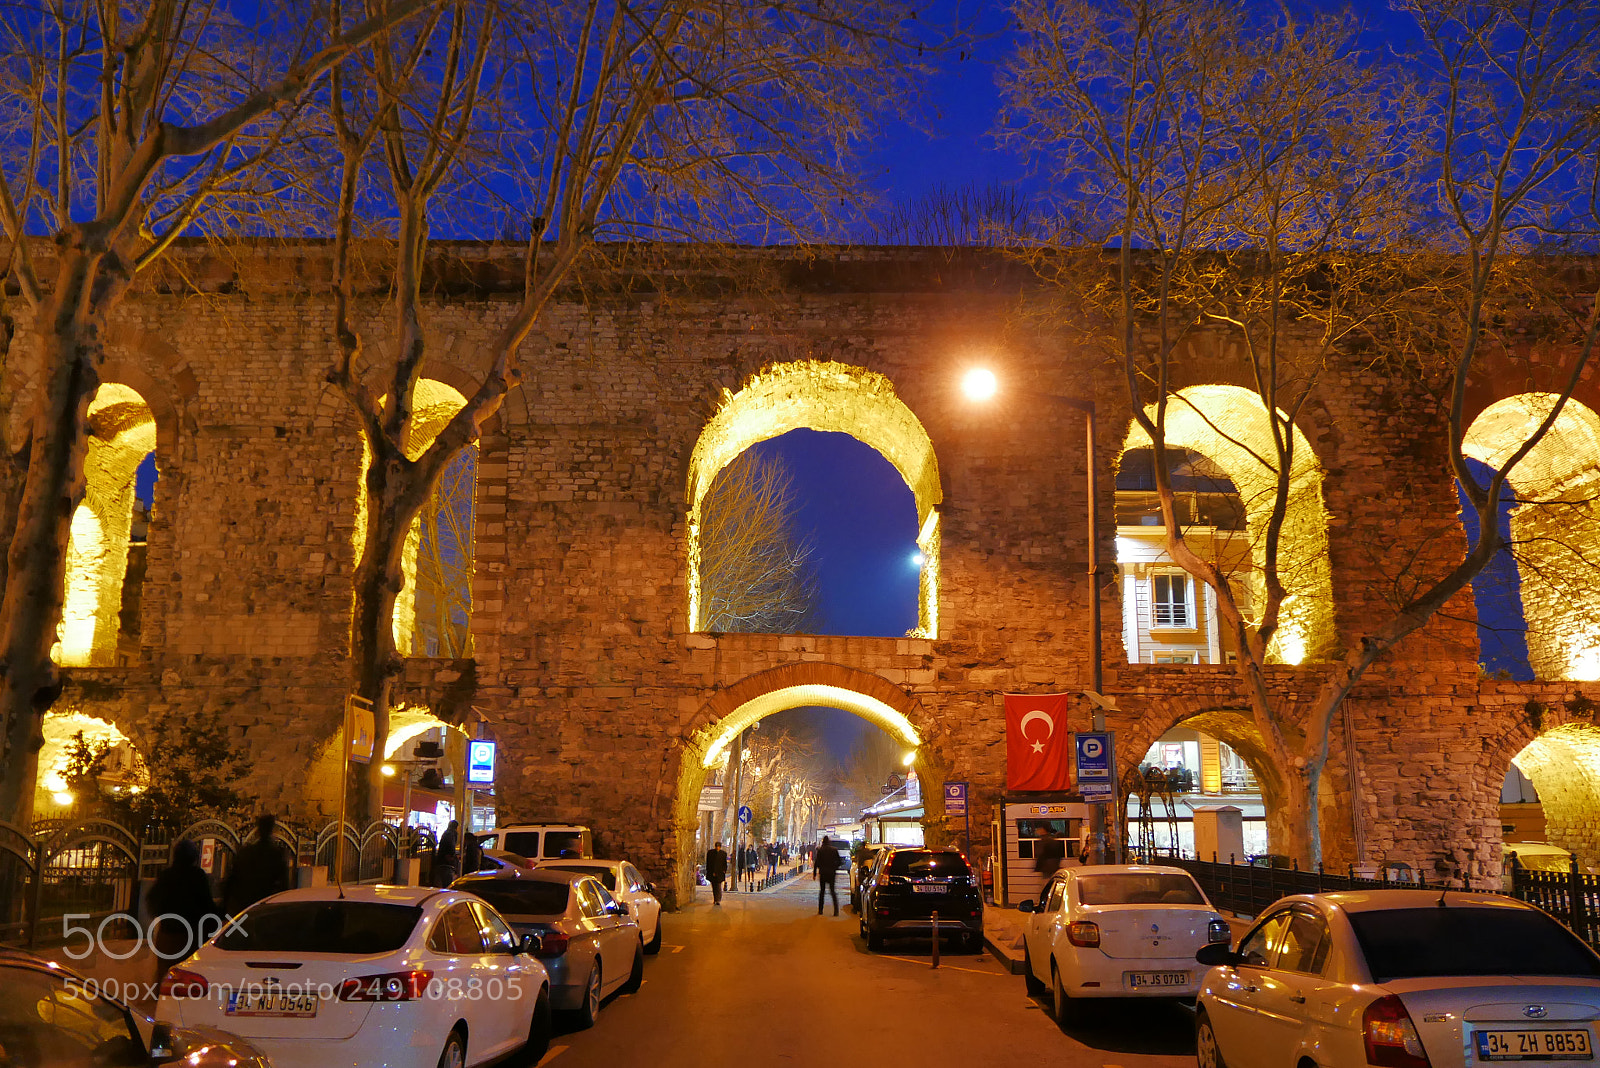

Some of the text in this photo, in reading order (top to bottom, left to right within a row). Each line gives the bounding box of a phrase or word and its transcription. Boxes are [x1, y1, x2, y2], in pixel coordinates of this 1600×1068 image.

[1087, 743, 1099, 753] P
[1136, 974, 1185, 985] 34 JS 0703
[1488, 1034, 1509, 1053] 34
[1517, 1034, 1539, 1053] ZH
[1544, 1034, 1587, 1052] 8853
